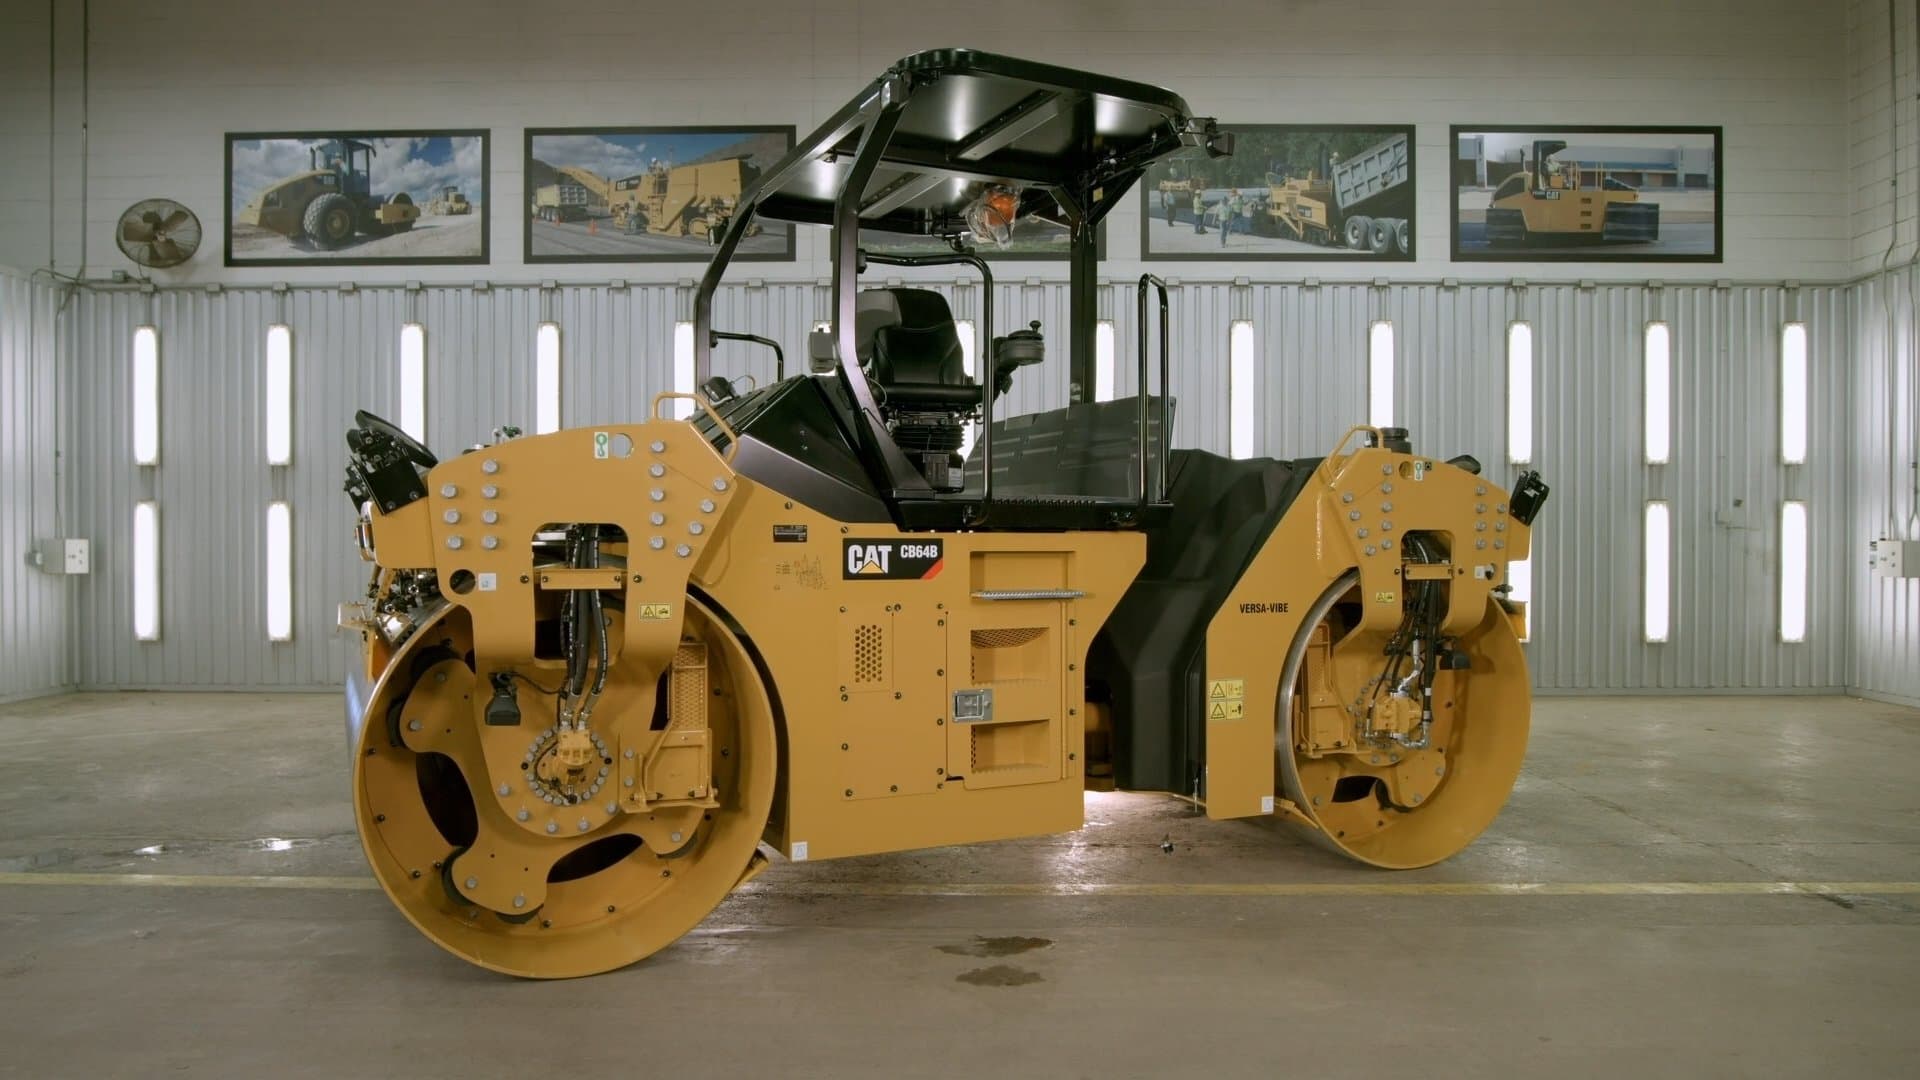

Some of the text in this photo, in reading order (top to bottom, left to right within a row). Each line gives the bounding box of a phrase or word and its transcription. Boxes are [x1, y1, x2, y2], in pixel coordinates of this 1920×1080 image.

[848, 544, 938, 574] CAT CB64B
[1239, 603, 1289, 613] VERSA-VIBE
